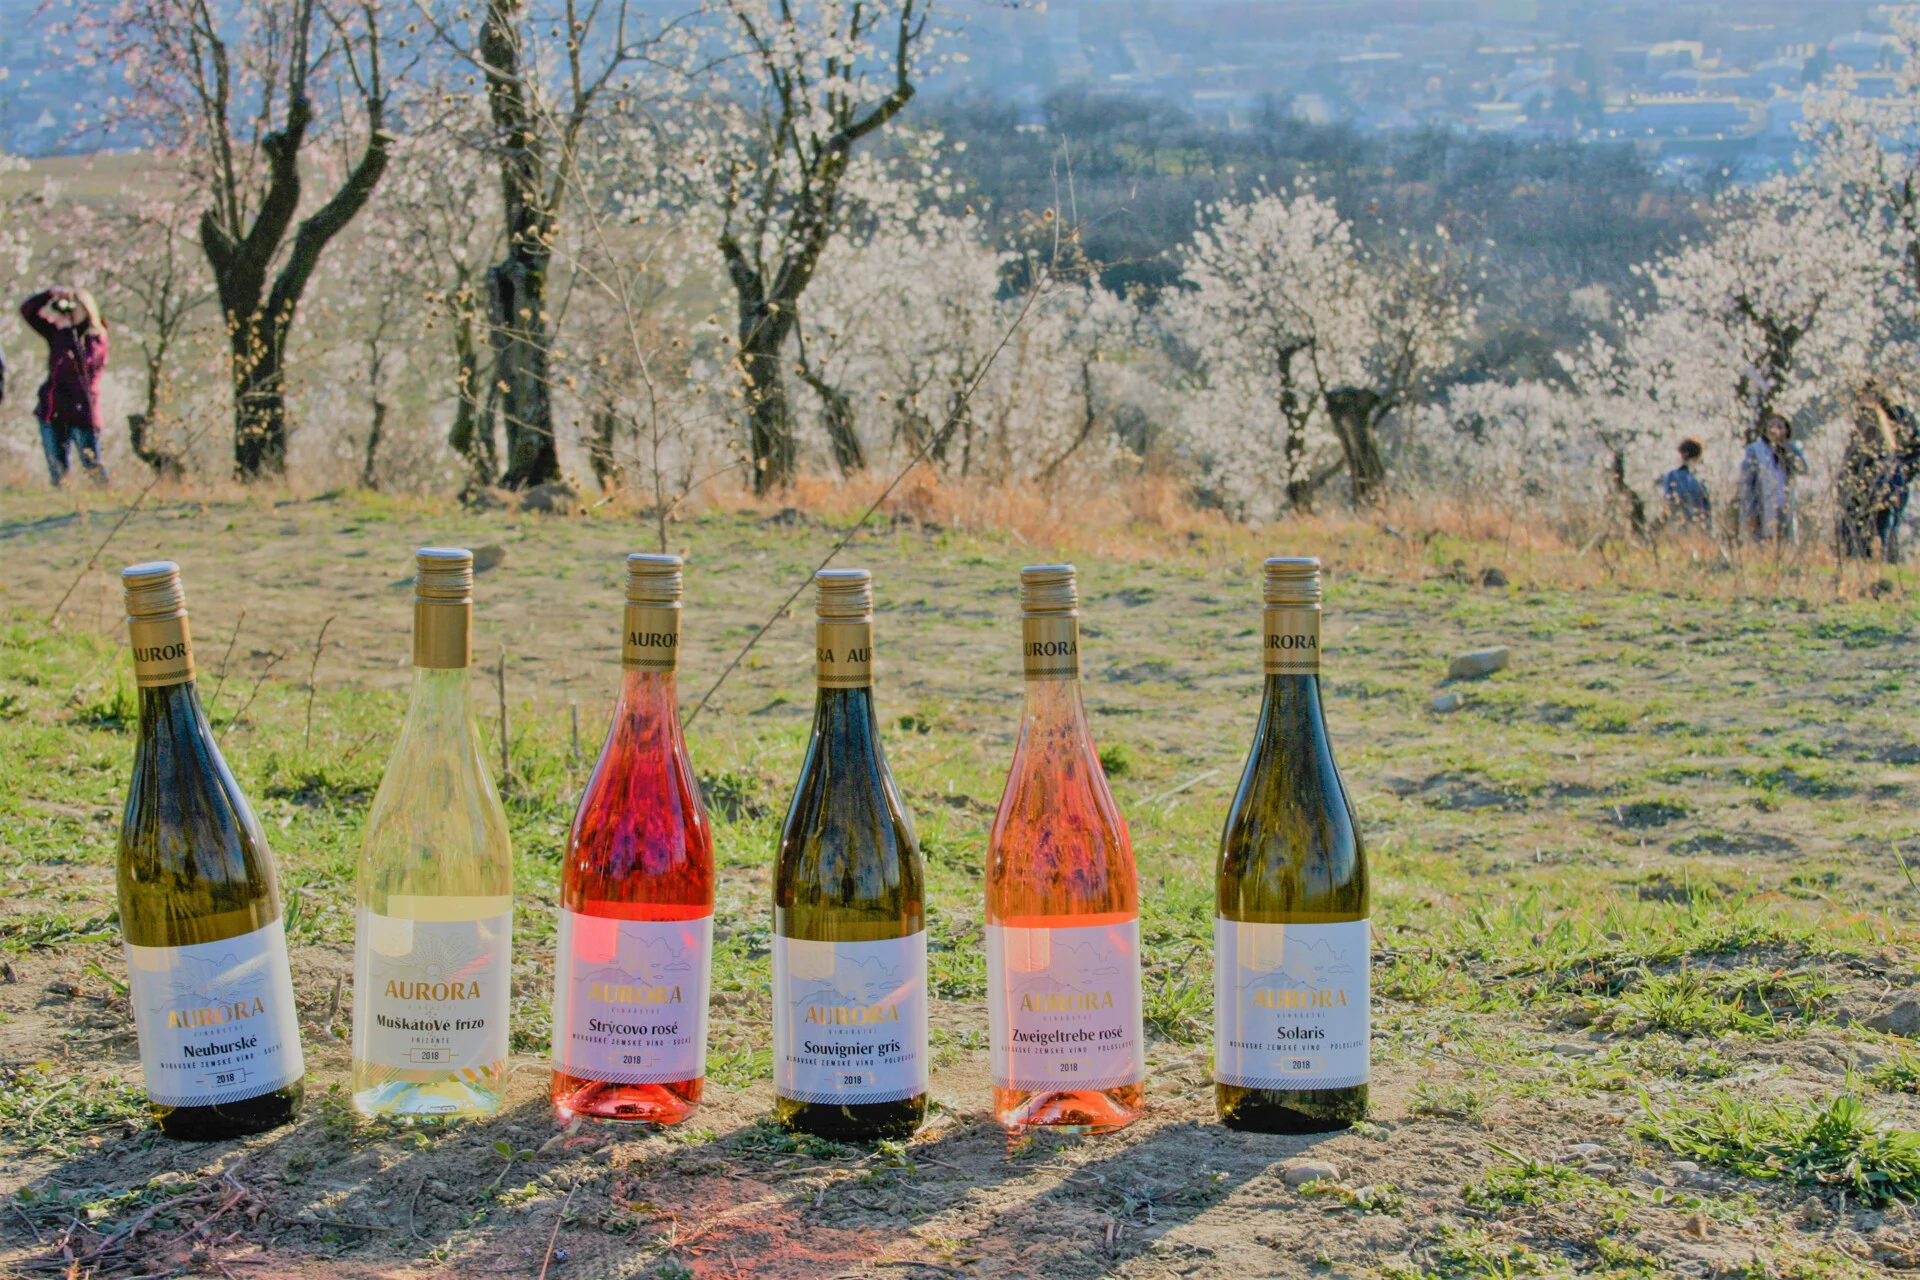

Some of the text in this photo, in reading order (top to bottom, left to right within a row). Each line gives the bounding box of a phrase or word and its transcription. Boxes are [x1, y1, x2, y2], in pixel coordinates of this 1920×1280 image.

[384, 979, 481, 1002] AURORA
[588, 983, 683, 1005] AURORA
[1252, 989, 1347, 1009] AURORA
[1020, 991, 1114, 1013] AURORA
[166, 996, 265, 1030] AURORA
[804, 1004, 899, 1026] AURORA
[588, 1018, 678, 1036] Strýcovo rosé
[1012, 1025, 1123, 1046] Zweigeltrebe rosé
[1277, 1026, 1325, 1040] Solaris
[184, 1034, 257, 1058] Neuburské
[421, 1051, 439, 1060] 2018
[804, 1039, 901, 1058] Souvignier gris
[623, 1055, 641, 1064] 2018
[1060, 1063, 1078, 1072] 2018
[1292, 1060, 1310, 1069] 2018
[216, 1073, 235, 1084] 2018
[844, 1076, 862, 1085] 2018
